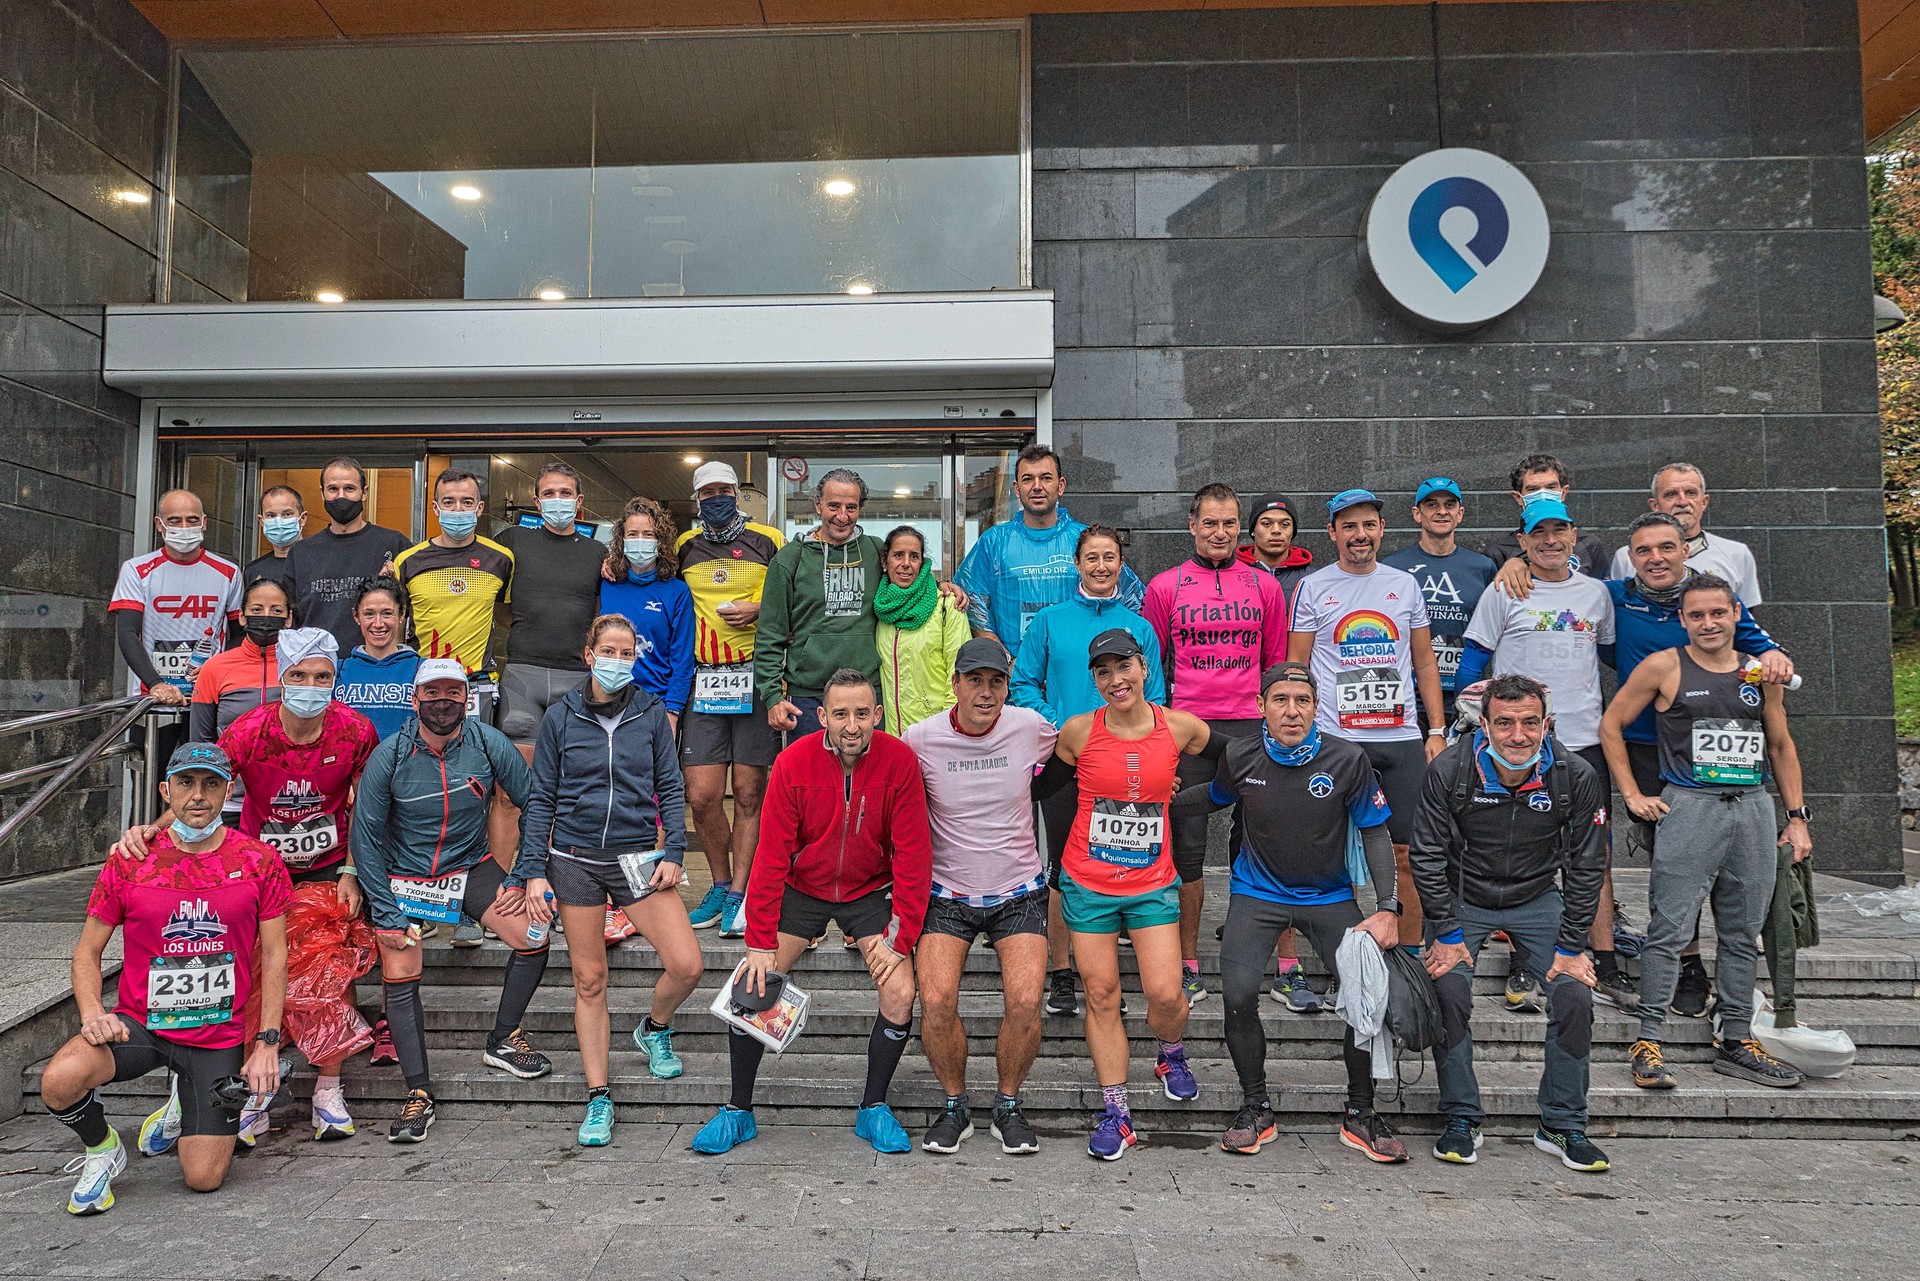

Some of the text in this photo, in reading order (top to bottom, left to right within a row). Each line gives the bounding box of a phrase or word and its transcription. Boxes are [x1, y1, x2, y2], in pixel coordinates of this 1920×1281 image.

[1053, 566, 1068, 574] DIZ
[311, 576, 364, 593] BUENAVIS
[829, 567, 865, 592] RUN
[828, 591, 854, 602] BILBAO
[153, 595, 219, 619] CAF
[1177, 599, 1262, 625] Triatlón
[1427, 604, 1461, 612] NGULAS
[1428, 611, 1468, 622] UINAGA
[1180, 627, 1258, 648] Pisuerga
[1340, 643, 1396, 658] BEHOBIA
[1191, 655, 1251, 670] Valladolid
[1340, 658, 1357, 666] SAN
[702, 675, 749, 689] 12141
[334, 683, 415, 706] SANSE
[1343, 683, 1400, 702] 5157
[1396, 705, 1402, 715] 5
[1699, 733, 1760, 754] 2075
[947, 756, 1009, 772] DE PUTA MADRE
[1716, 755, 1747, 763] SERGIO
[272, 804, 321, 818] LOS LUNES
[1098, 818, 1158, 837] 10791
[266, 831, 332, 854] 2309
[1110, 838, 1140, 847] AINHOA
[1152, 844, 1158, 854] 8
[405, 887, 445, 900] TXOPERAS
[451, 900, 458, 910] 8
[164, 940, 224, 954] LOS LUNES
[155, 969, 230, 996] 2314
[173, 996, 211, 1006] JUANJO
[223, 997, 231, 1008] 3
